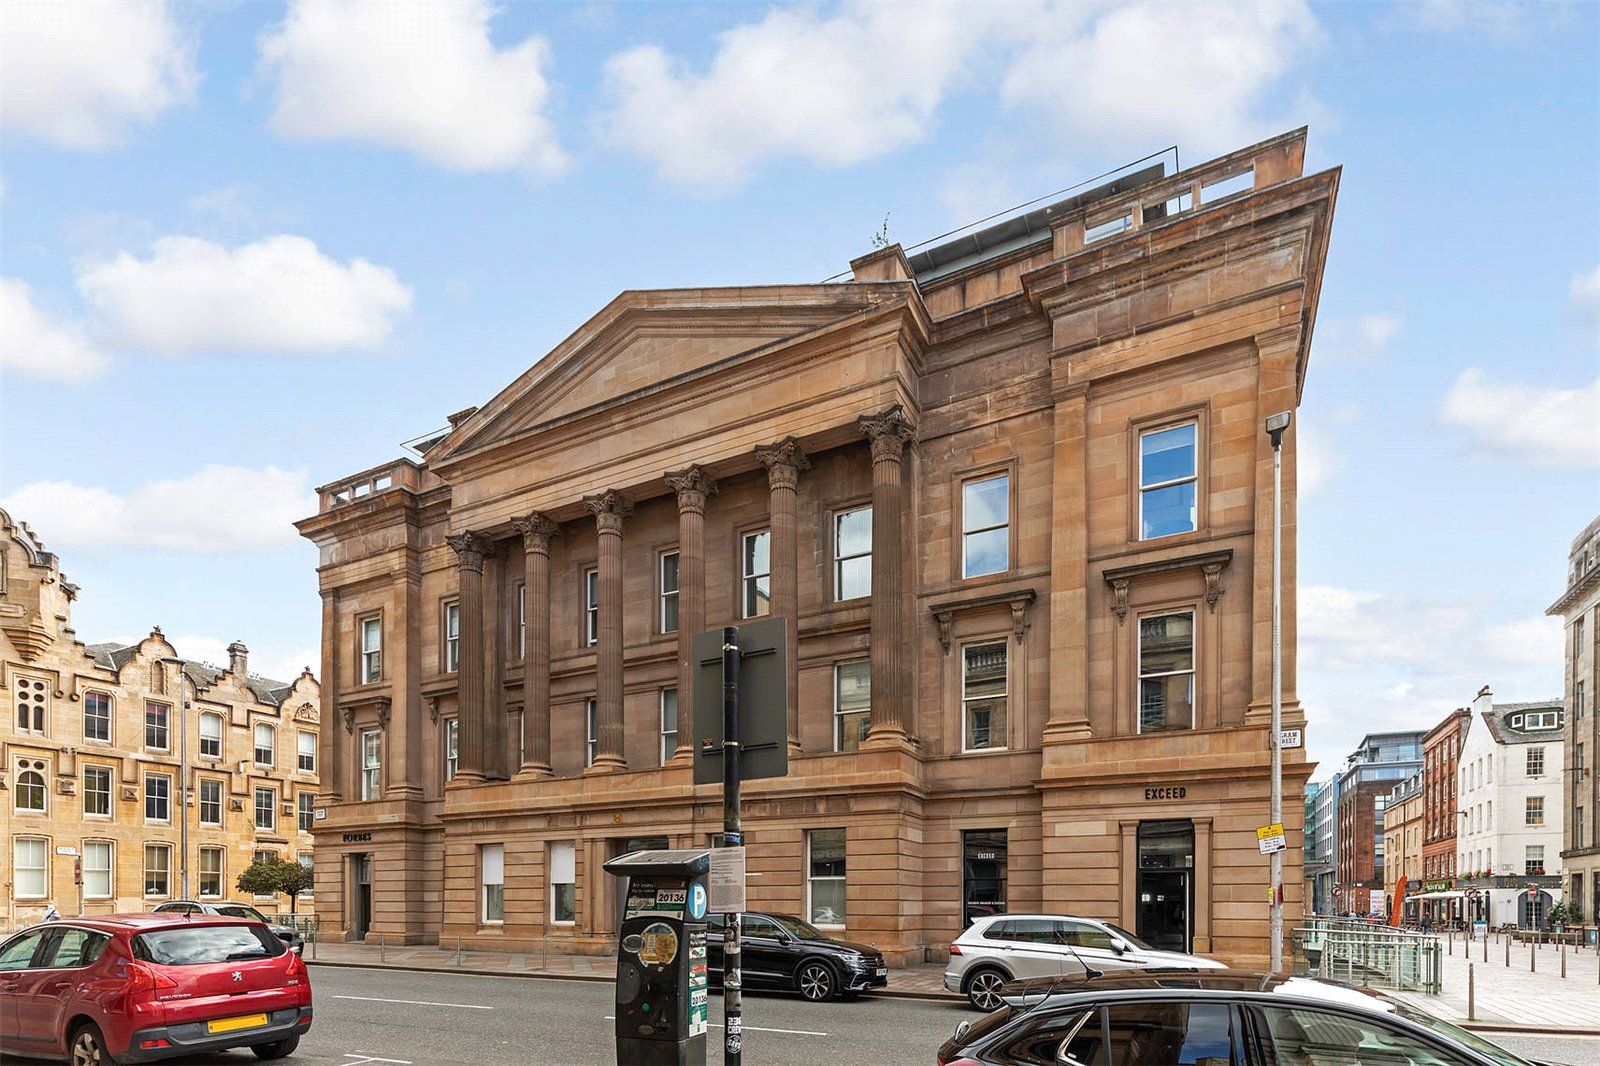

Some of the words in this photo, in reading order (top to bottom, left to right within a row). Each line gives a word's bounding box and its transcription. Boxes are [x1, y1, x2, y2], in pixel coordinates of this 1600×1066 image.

[1144, 787, 1186, 800] EXCEED
[977, 852, 995, 860] EXCEED
[658, 893, 685, 902] 20136
